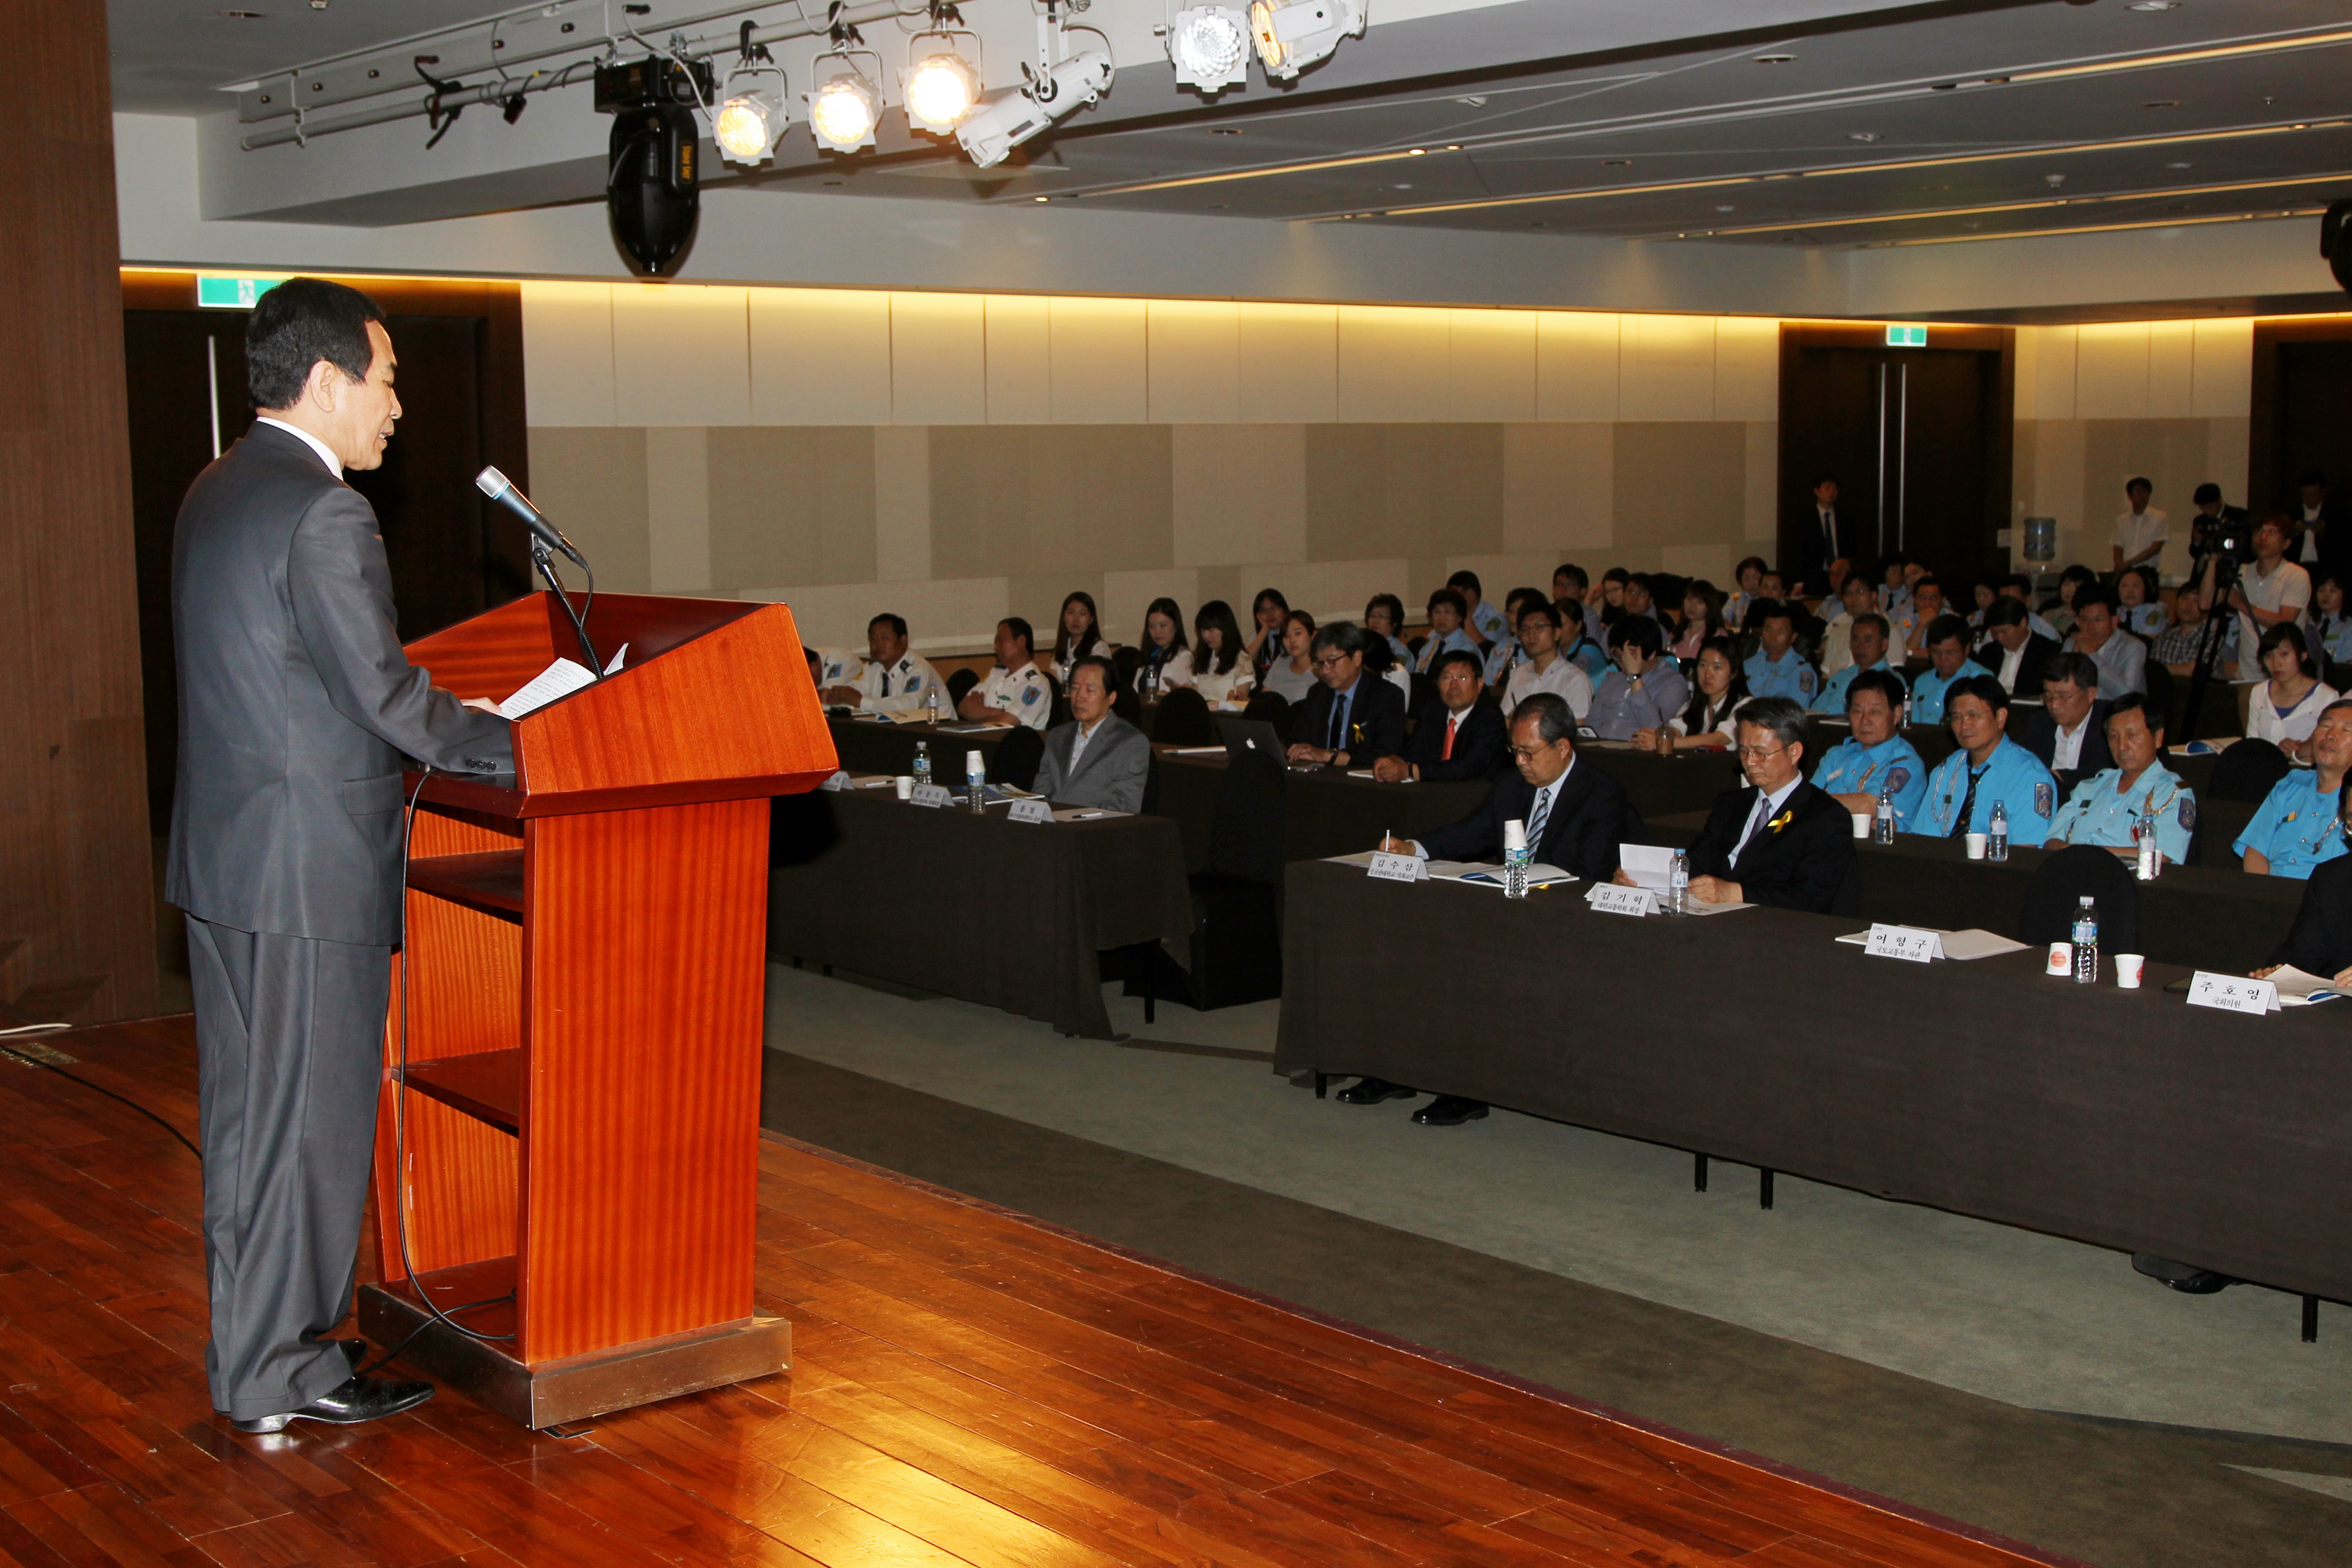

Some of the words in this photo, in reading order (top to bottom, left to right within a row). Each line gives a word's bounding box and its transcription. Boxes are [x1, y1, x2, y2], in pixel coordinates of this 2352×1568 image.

[1876, 945, 1906, 957] 국토교통부
[1908, 951, 1921, 959] 차관
[2213, 996, 2241, 1008] 국회의원
